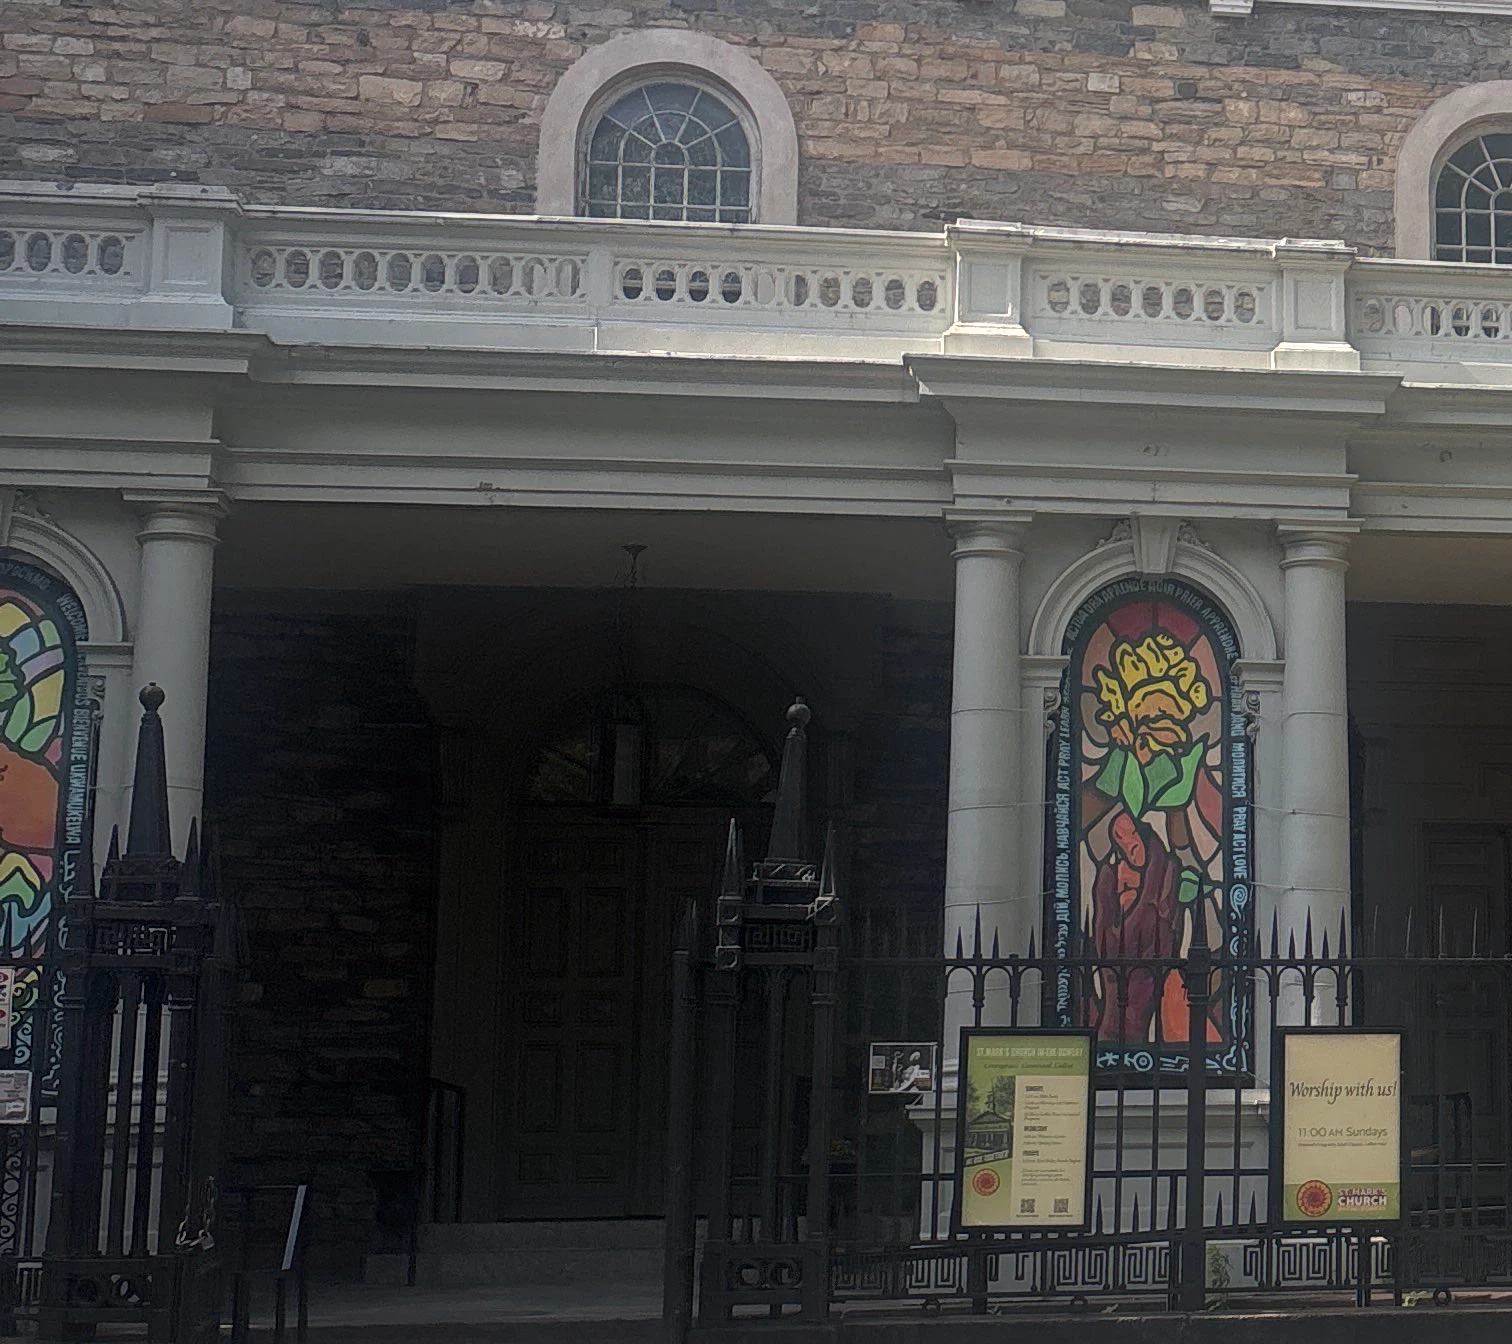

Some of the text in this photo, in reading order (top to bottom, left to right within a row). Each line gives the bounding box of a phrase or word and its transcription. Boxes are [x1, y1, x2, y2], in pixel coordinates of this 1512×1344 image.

[56, 592, 88, 641] WELCOME
[1174, 586, 1203, 610] PRIER
[1200, 607, 1239, 661] APPRENDRE
[71, 708, 91, 761] BIENVENUE
[1058, 705, 1071, 738] LEARN
[1057, 739, 1071, 767] PRAY
[1056, 767, 1070, 791] ACT
[1232, 806, 1248, 879] PRAY ACT LOVE
[1289, 1077, 1398, 1105] Worship with us!
[1298, 1126, 1388, 1140] 11:00 AM Sundays
[1337, 1196, 1388, 1206] CHURCH
